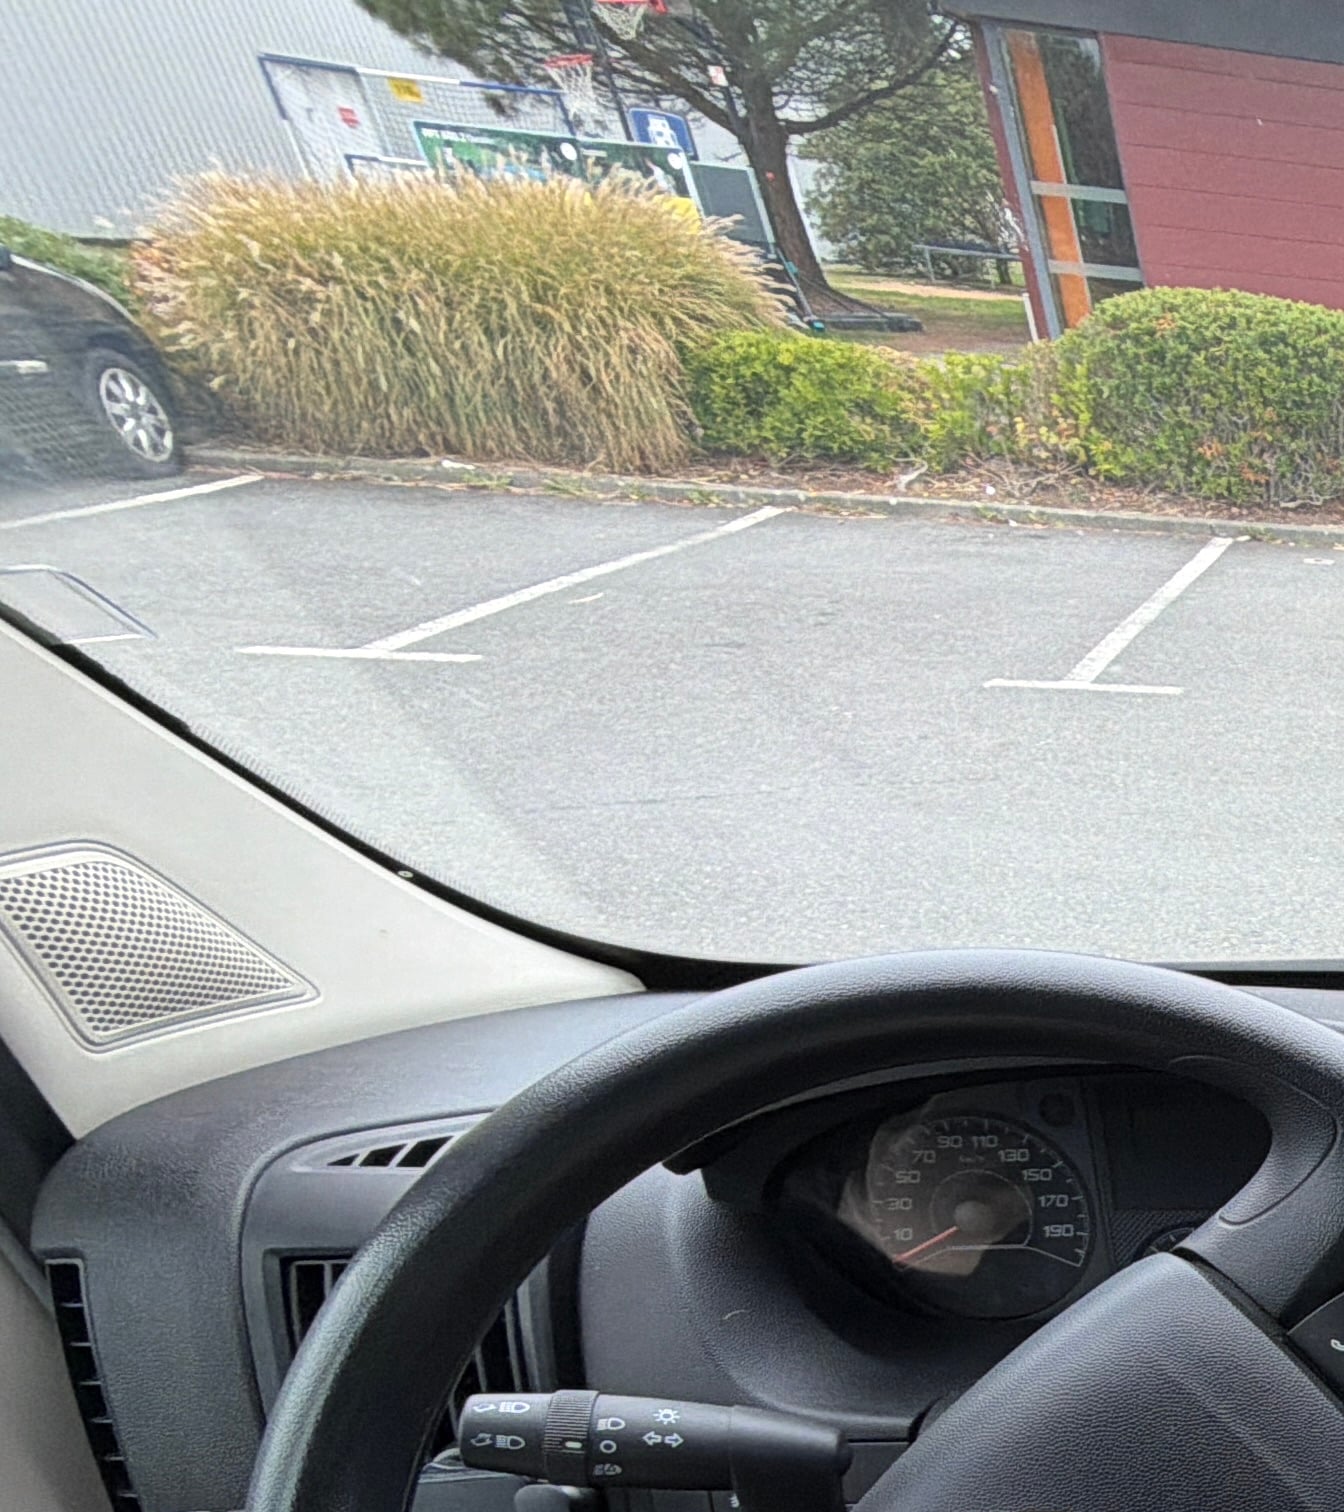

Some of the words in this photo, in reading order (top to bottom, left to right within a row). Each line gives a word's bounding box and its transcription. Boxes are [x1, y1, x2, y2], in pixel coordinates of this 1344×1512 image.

[937, 1136, 962, 1148] 90
[972, 1135, 999, 1148] 110
[912, 1151, 936, 1163] 70
[998, 1150, 1030, 1162] 130
[895, 1171, 920, 1184] 50
[1023, 1169, 1052, 1182] 150
[887, 1198, 912, 1210] 30
[1039, 1194, 1068, 1208] 170
[894, 1227, 913, 1241] 10
[1043, 1224, 1074, 1238] 190
